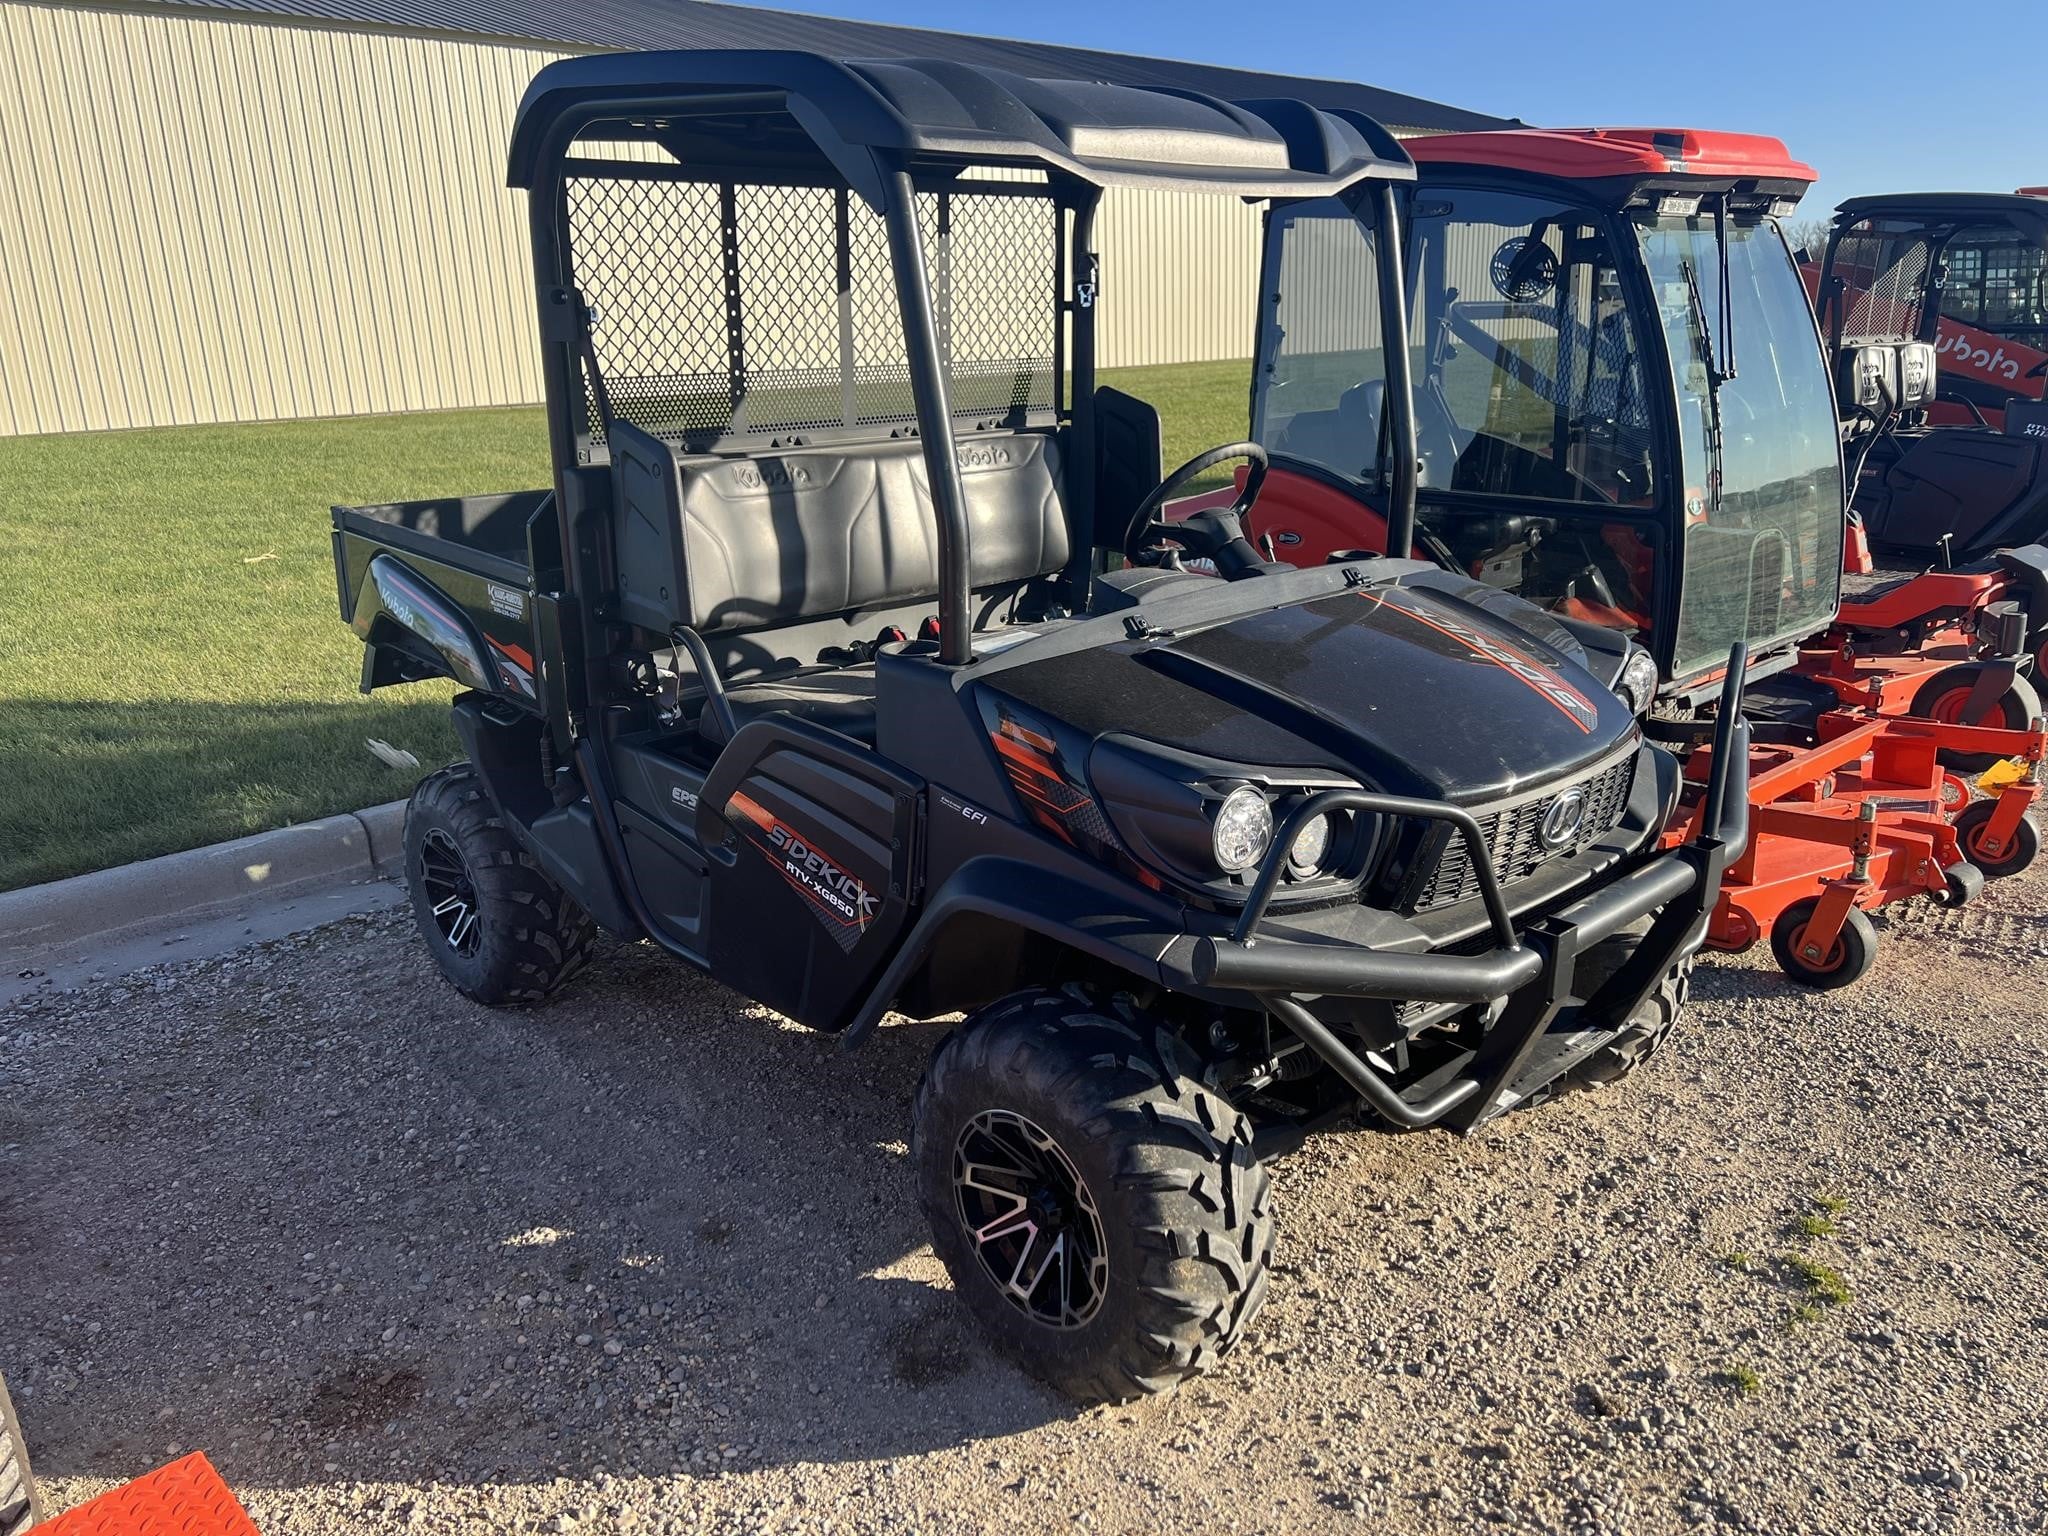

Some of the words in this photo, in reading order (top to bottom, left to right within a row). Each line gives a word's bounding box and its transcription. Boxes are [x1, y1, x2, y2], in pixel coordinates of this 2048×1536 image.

[1935, 330, 2019, 379] ubota
[957, 445, 1011, 468] ubota
[381, 586, 414, 628] Kubota
[1400, 605, 1592, 714] SIDEKICK
[672, 786, 699, 808] EPS
[962, 807, 988, 825] EFI
[766, 825, 880, 916] SIDEKICK
[785, 860, 855, 918] RTV-XG850
